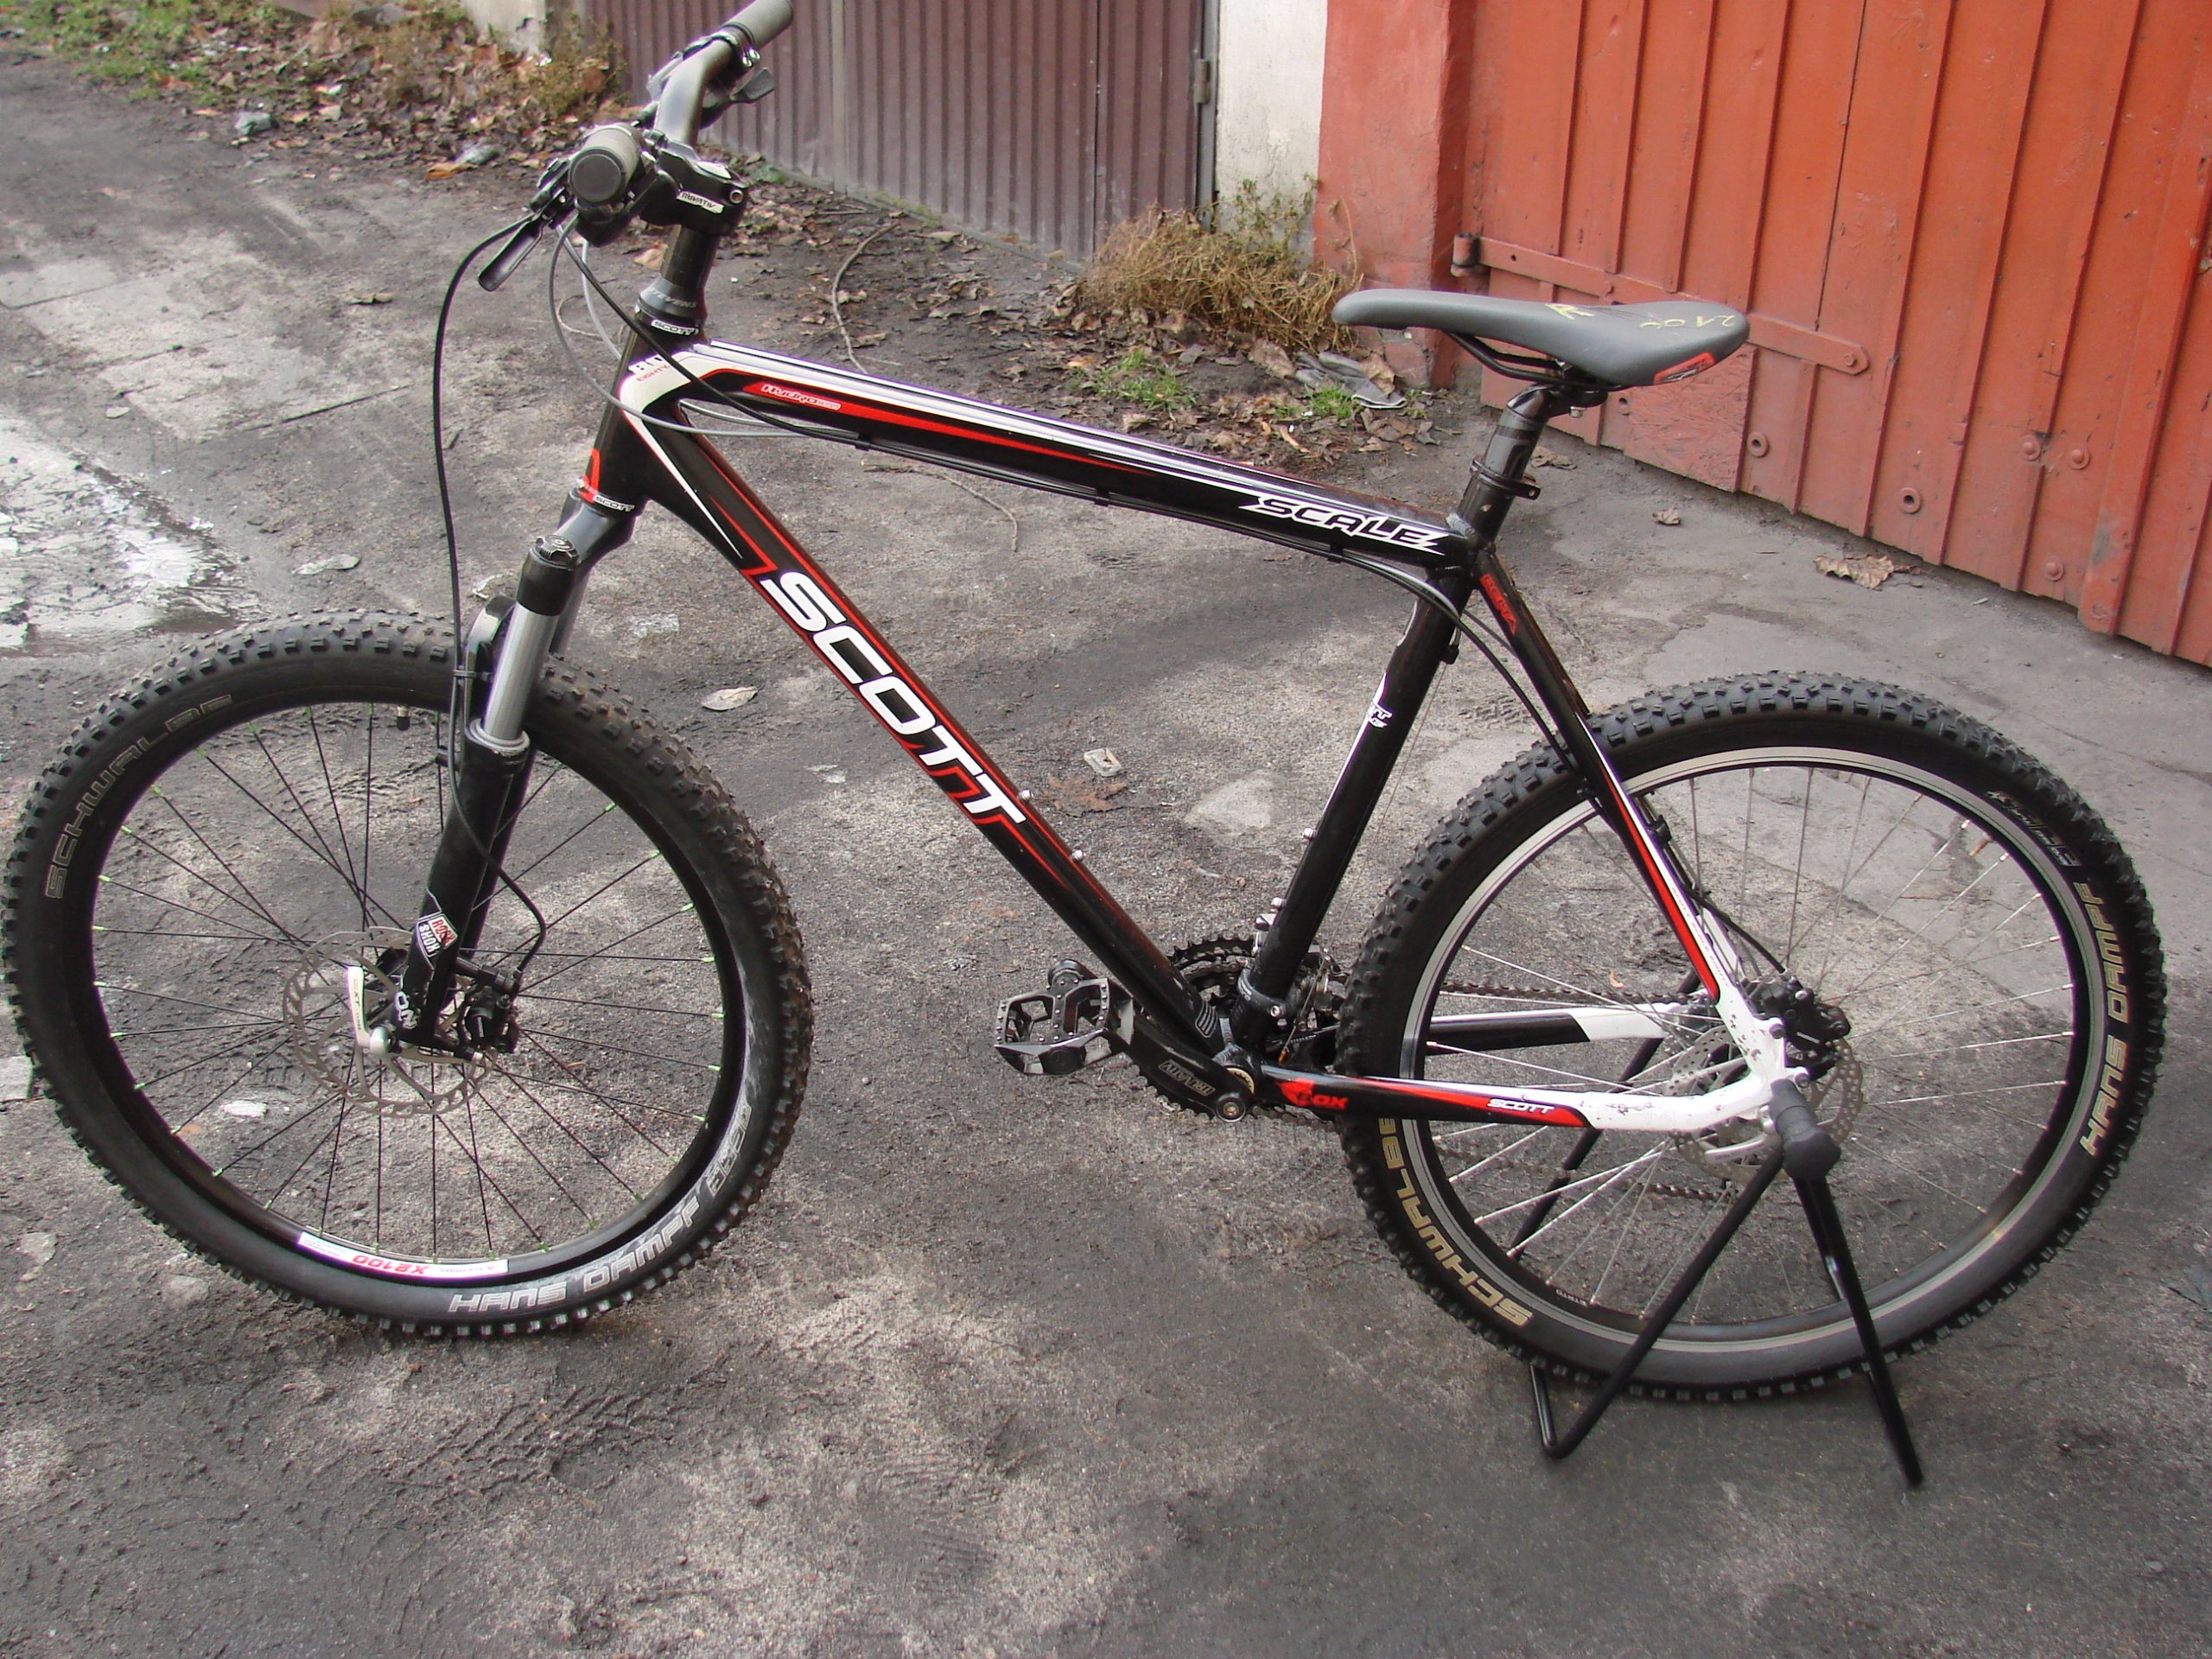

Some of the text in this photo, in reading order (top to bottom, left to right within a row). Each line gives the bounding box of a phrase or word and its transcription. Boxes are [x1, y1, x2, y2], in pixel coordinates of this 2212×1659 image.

[1241, 496, 1448, 554] SCALE
[760, 570, 1027, 823] SCOTT
[2074, 880, 2129, 1158] HANS DAMPF
[1160, 1060, 1213, 1096] TRUVATIV
[1487, 1098, 1554, 1114] SCOTT
[351, 1253, 430, 1277] X2100
[448, 1195, 701, 1313] HANS DAMPF
